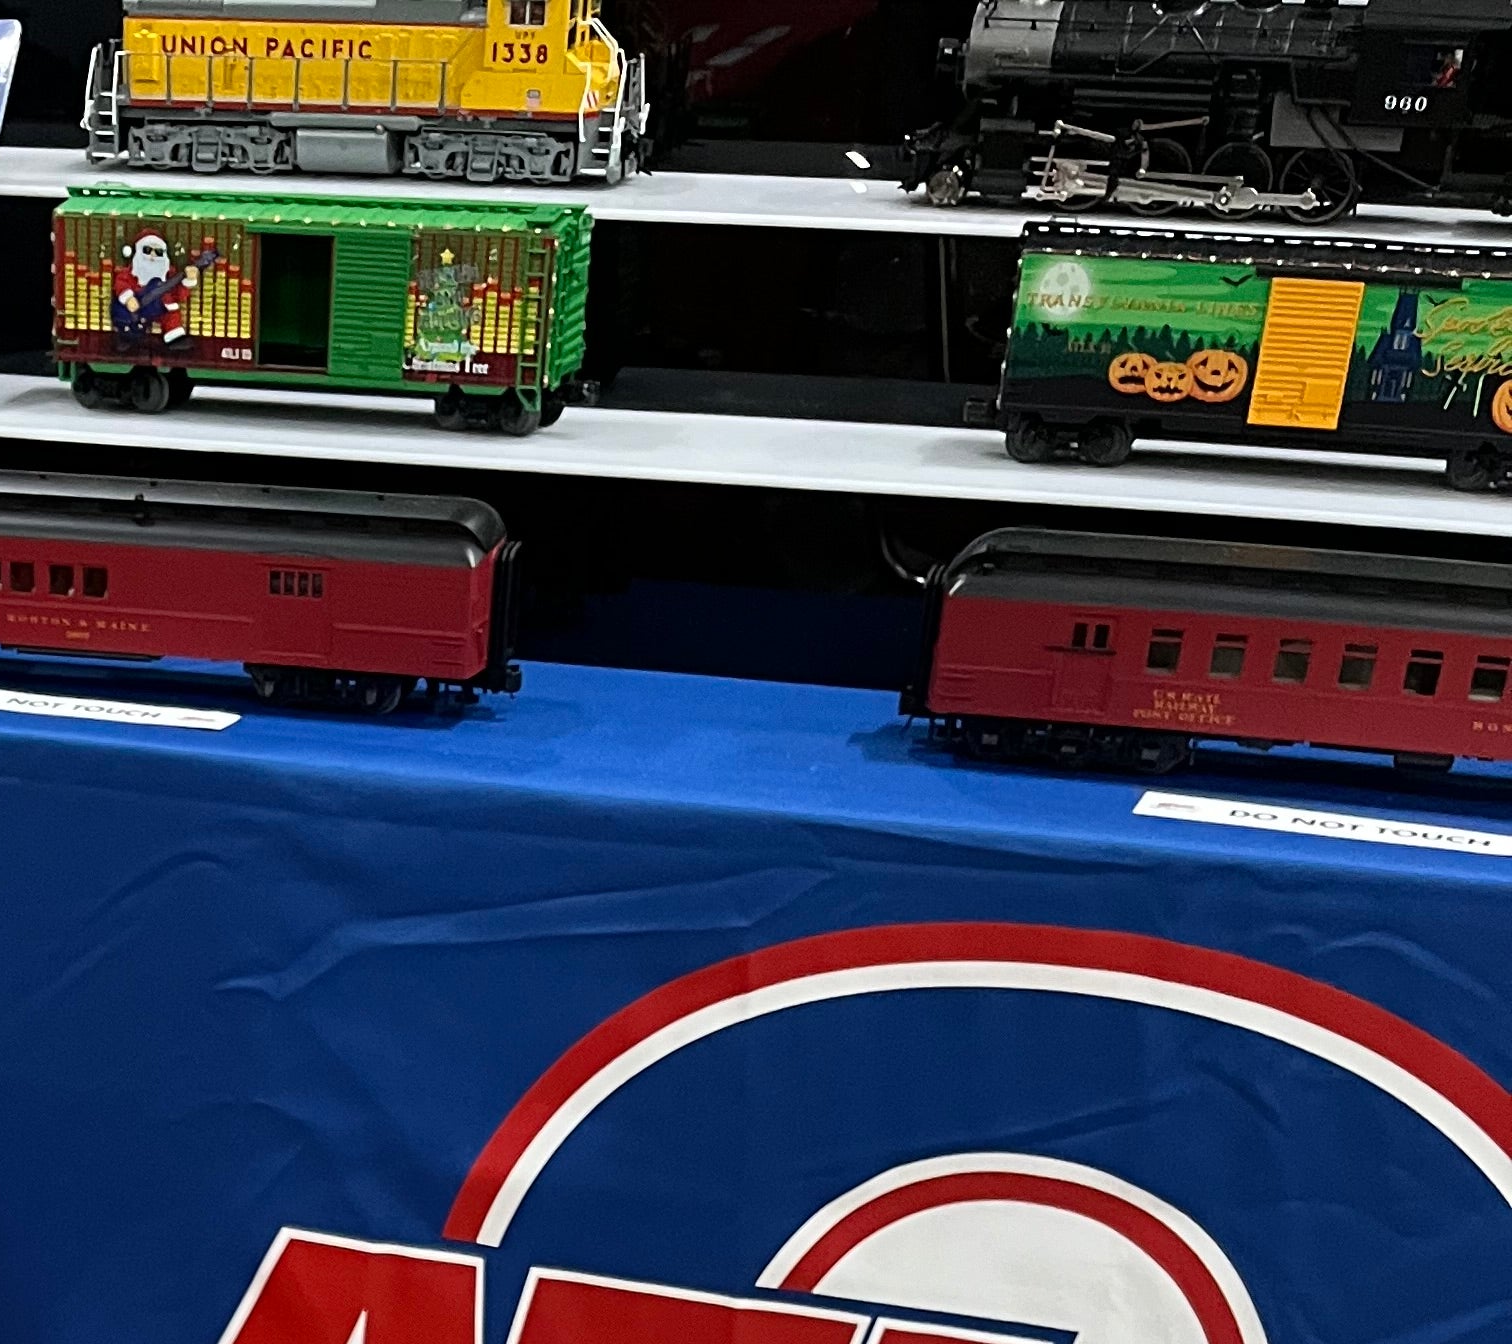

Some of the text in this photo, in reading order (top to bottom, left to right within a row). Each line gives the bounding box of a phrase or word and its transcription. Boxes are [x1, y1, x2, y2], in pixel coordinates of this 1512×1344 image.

[162, 35, 372, 59] UNION PACIFIC
[492, 42, 548, 64] 1338
[6, 697, 65, 710] NOT
[72, 703, 162, 719] TOUCH
[1229, 809, 1491, 847] DO NOT TOUCH
